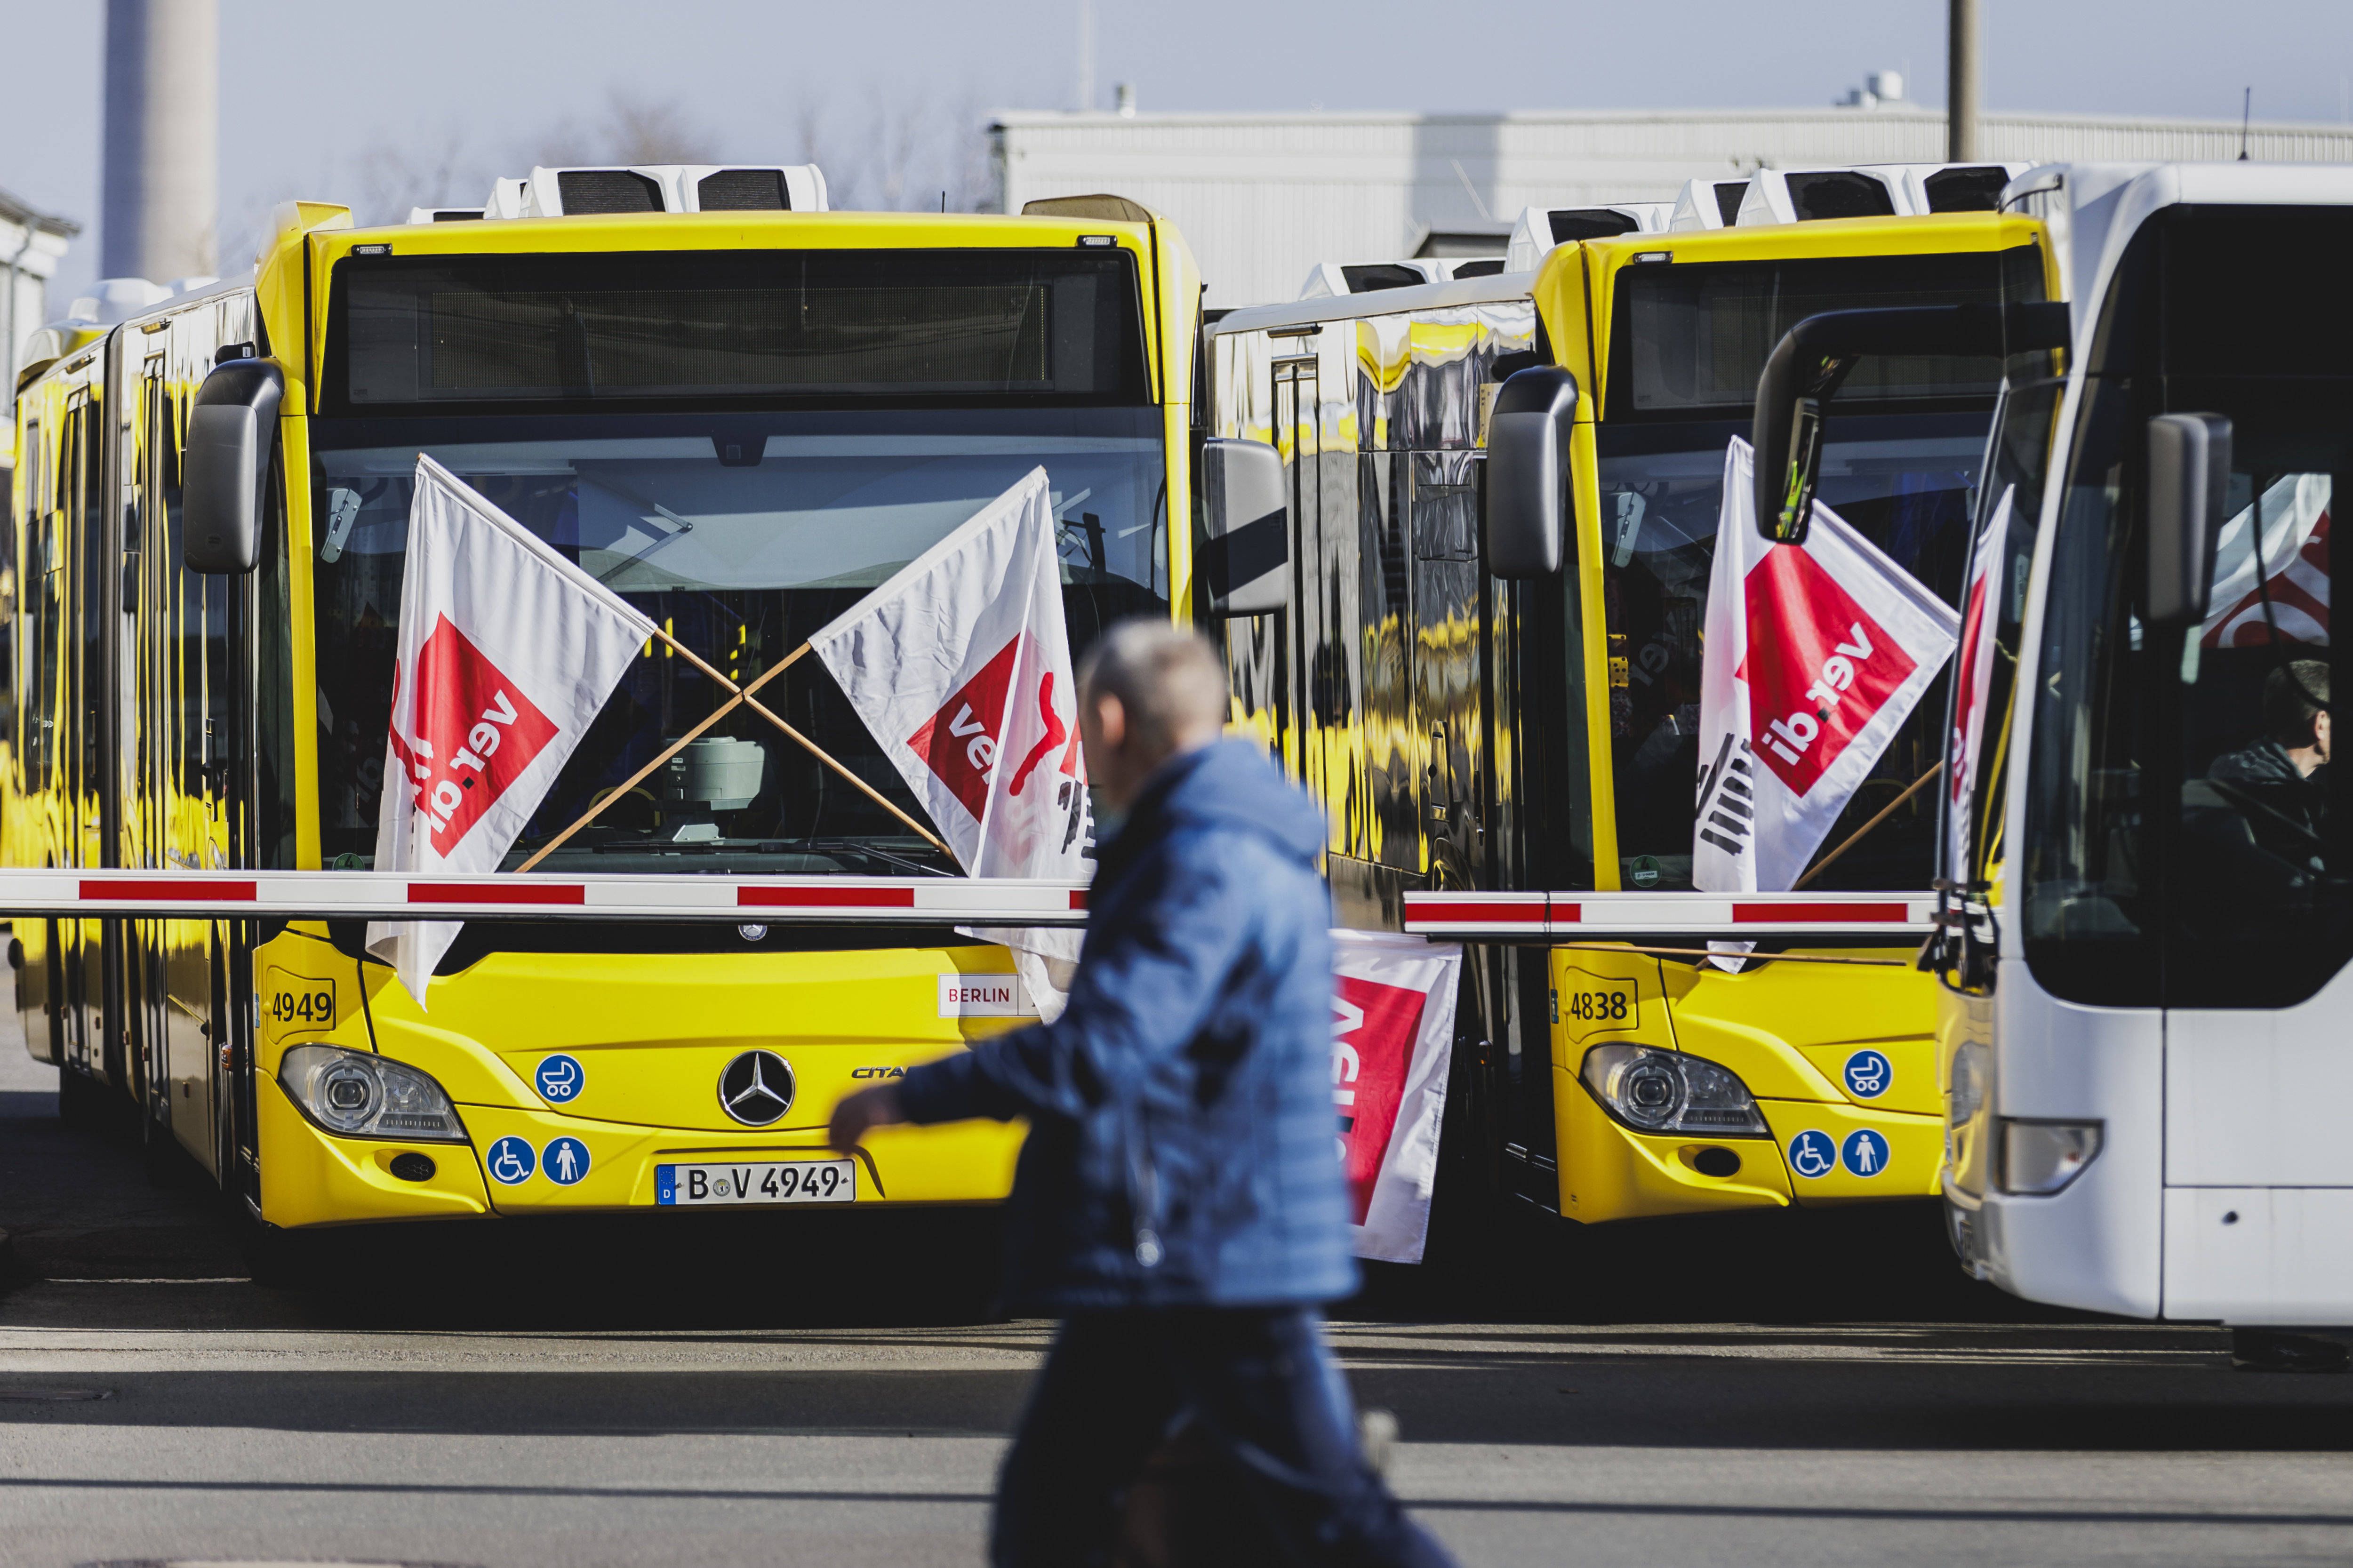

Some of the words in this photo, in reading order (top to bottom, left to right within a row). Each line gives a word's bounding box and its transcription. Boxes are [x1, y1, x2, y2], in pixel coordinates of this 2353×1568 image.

[344, 855, 353, 869] 4
[949, 988, 1009, 1002] BERLIN
[272, 992, 332, 1022] 4949
[1571, 992, 1627, 1020] 4838
[852, 1066, 904, 1079] CITA
[689, 1169, 709, 1200] B
[732, 1168, 752, 1199] V
[761, 1167, 840, 1198] 4949
[664, 1189, 671, 1199] D
